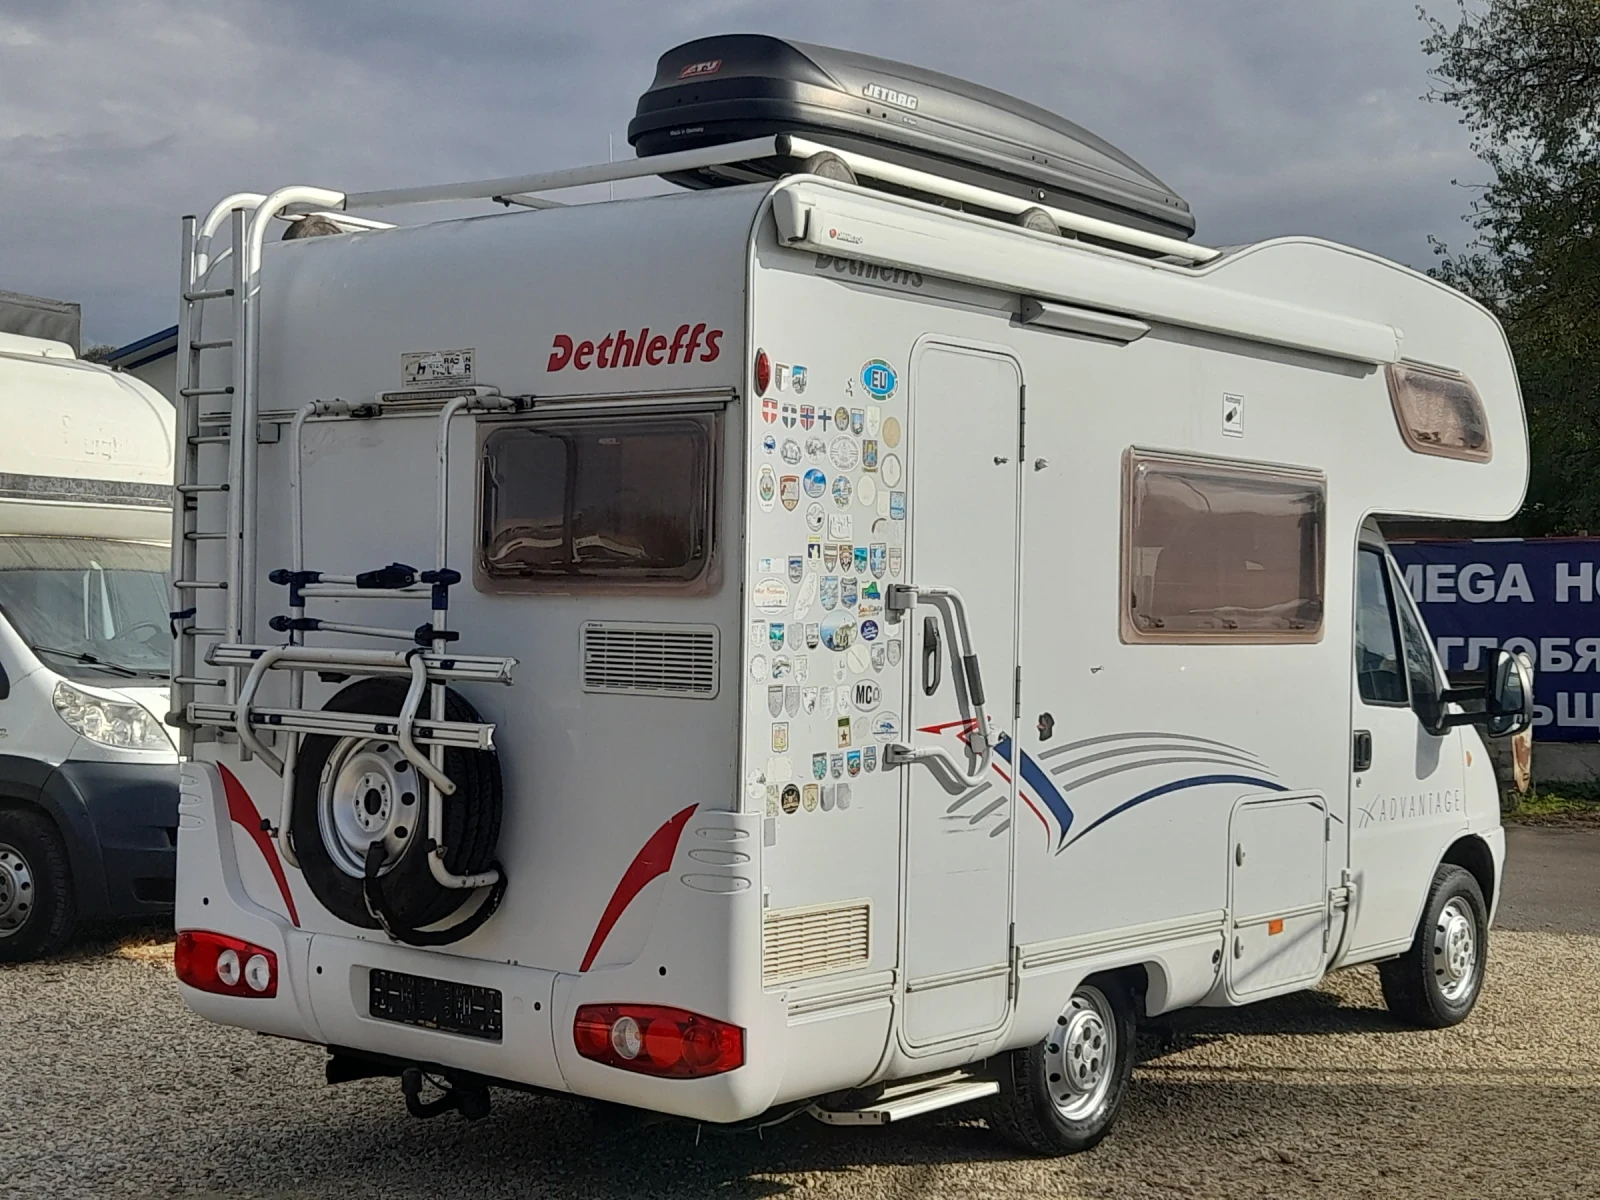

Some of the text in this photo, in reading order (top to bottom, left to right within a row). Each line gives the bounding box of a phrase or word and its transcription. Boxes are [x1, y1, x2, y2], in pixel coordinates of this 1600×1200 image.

[863, 83, 917, 110] JETBAG
[547, 322, 724, 372] Dethleffs
[872, 370, 887, 390] EU
[1555, 562, 1600, 603] H
